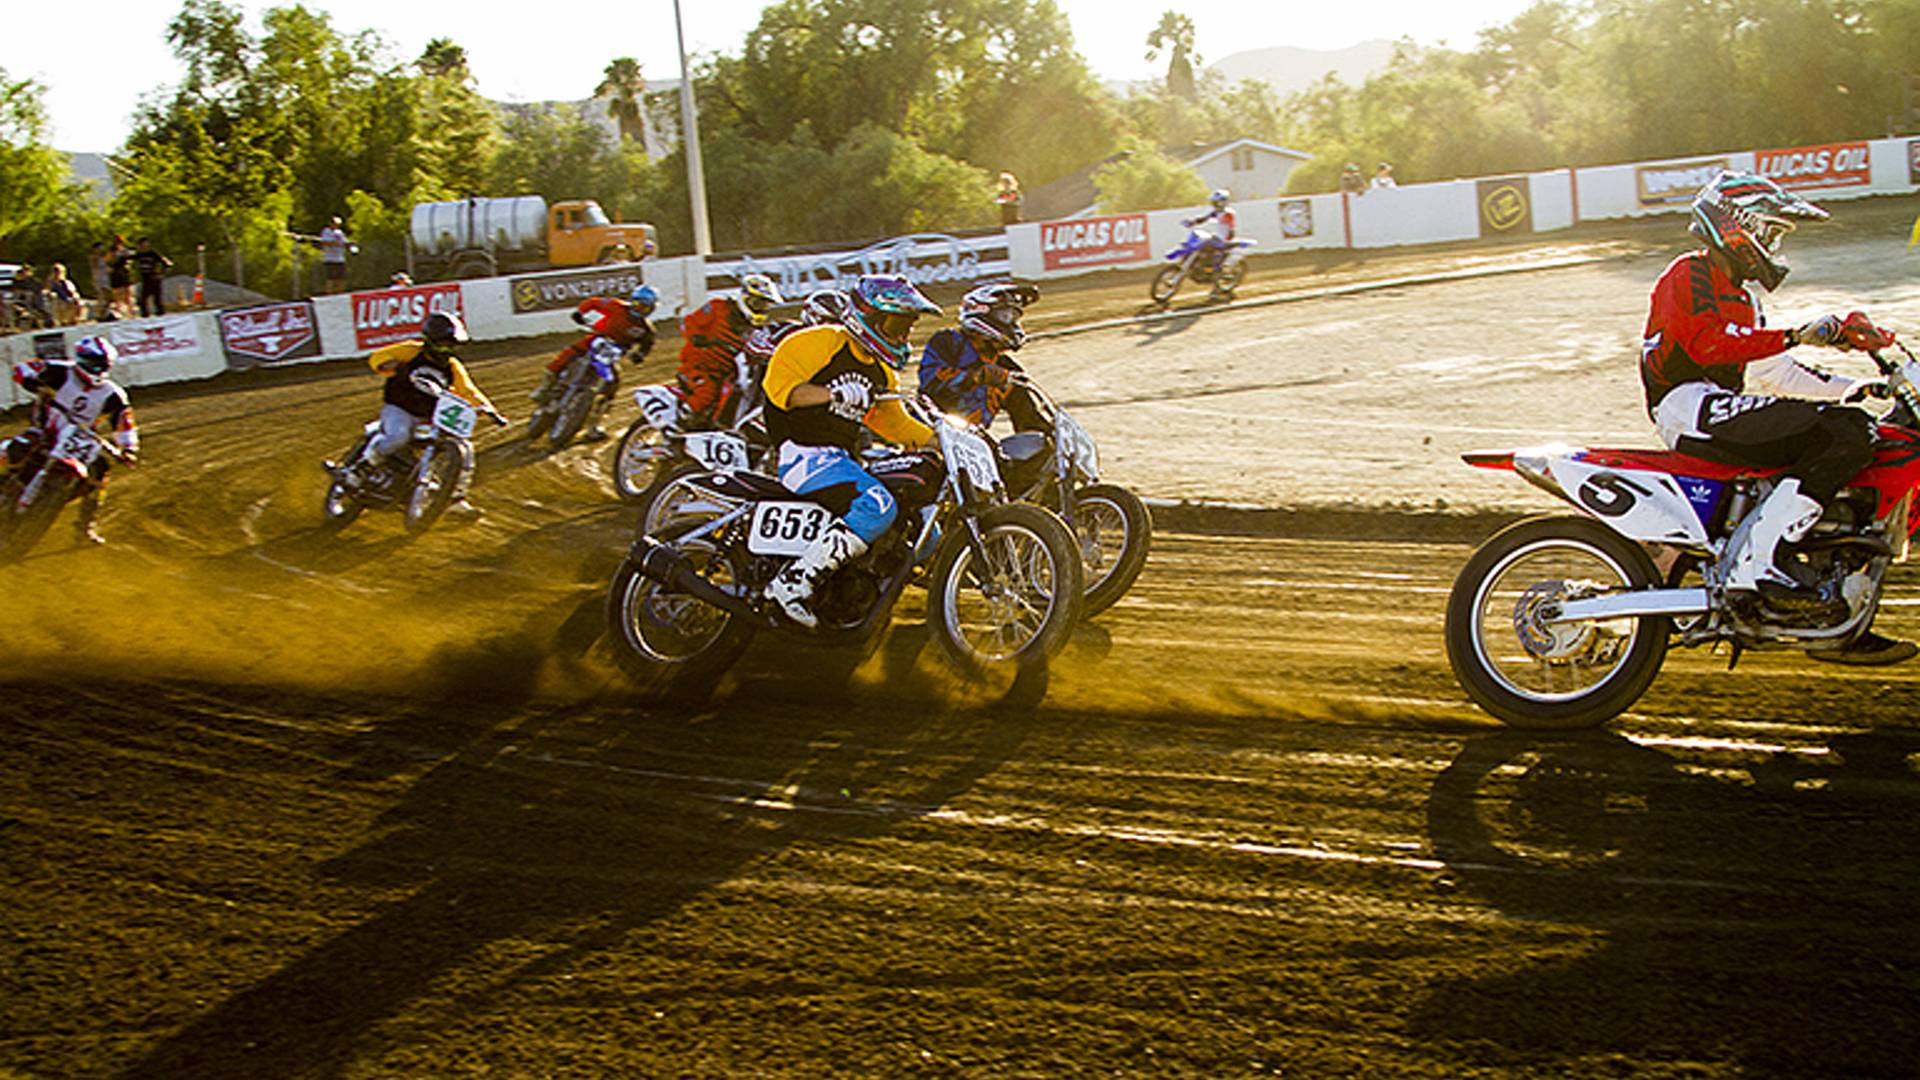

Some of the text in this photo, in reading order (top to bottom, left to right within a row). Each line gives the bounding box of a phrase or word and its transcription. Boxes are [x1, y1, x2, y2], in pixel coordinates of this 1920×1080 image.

[1759, 147, 1869, 178] LUCAS OIL
[1043, 218, 1146, 251] LUCAS OIL
[356, 295, 425, 329] LUCAS
[439, 404, 463, 429] 4
[703, 439, 734, 465] 16
[1578, 471, 1654, 517] 5
[760, 506, 824, 541] 653
